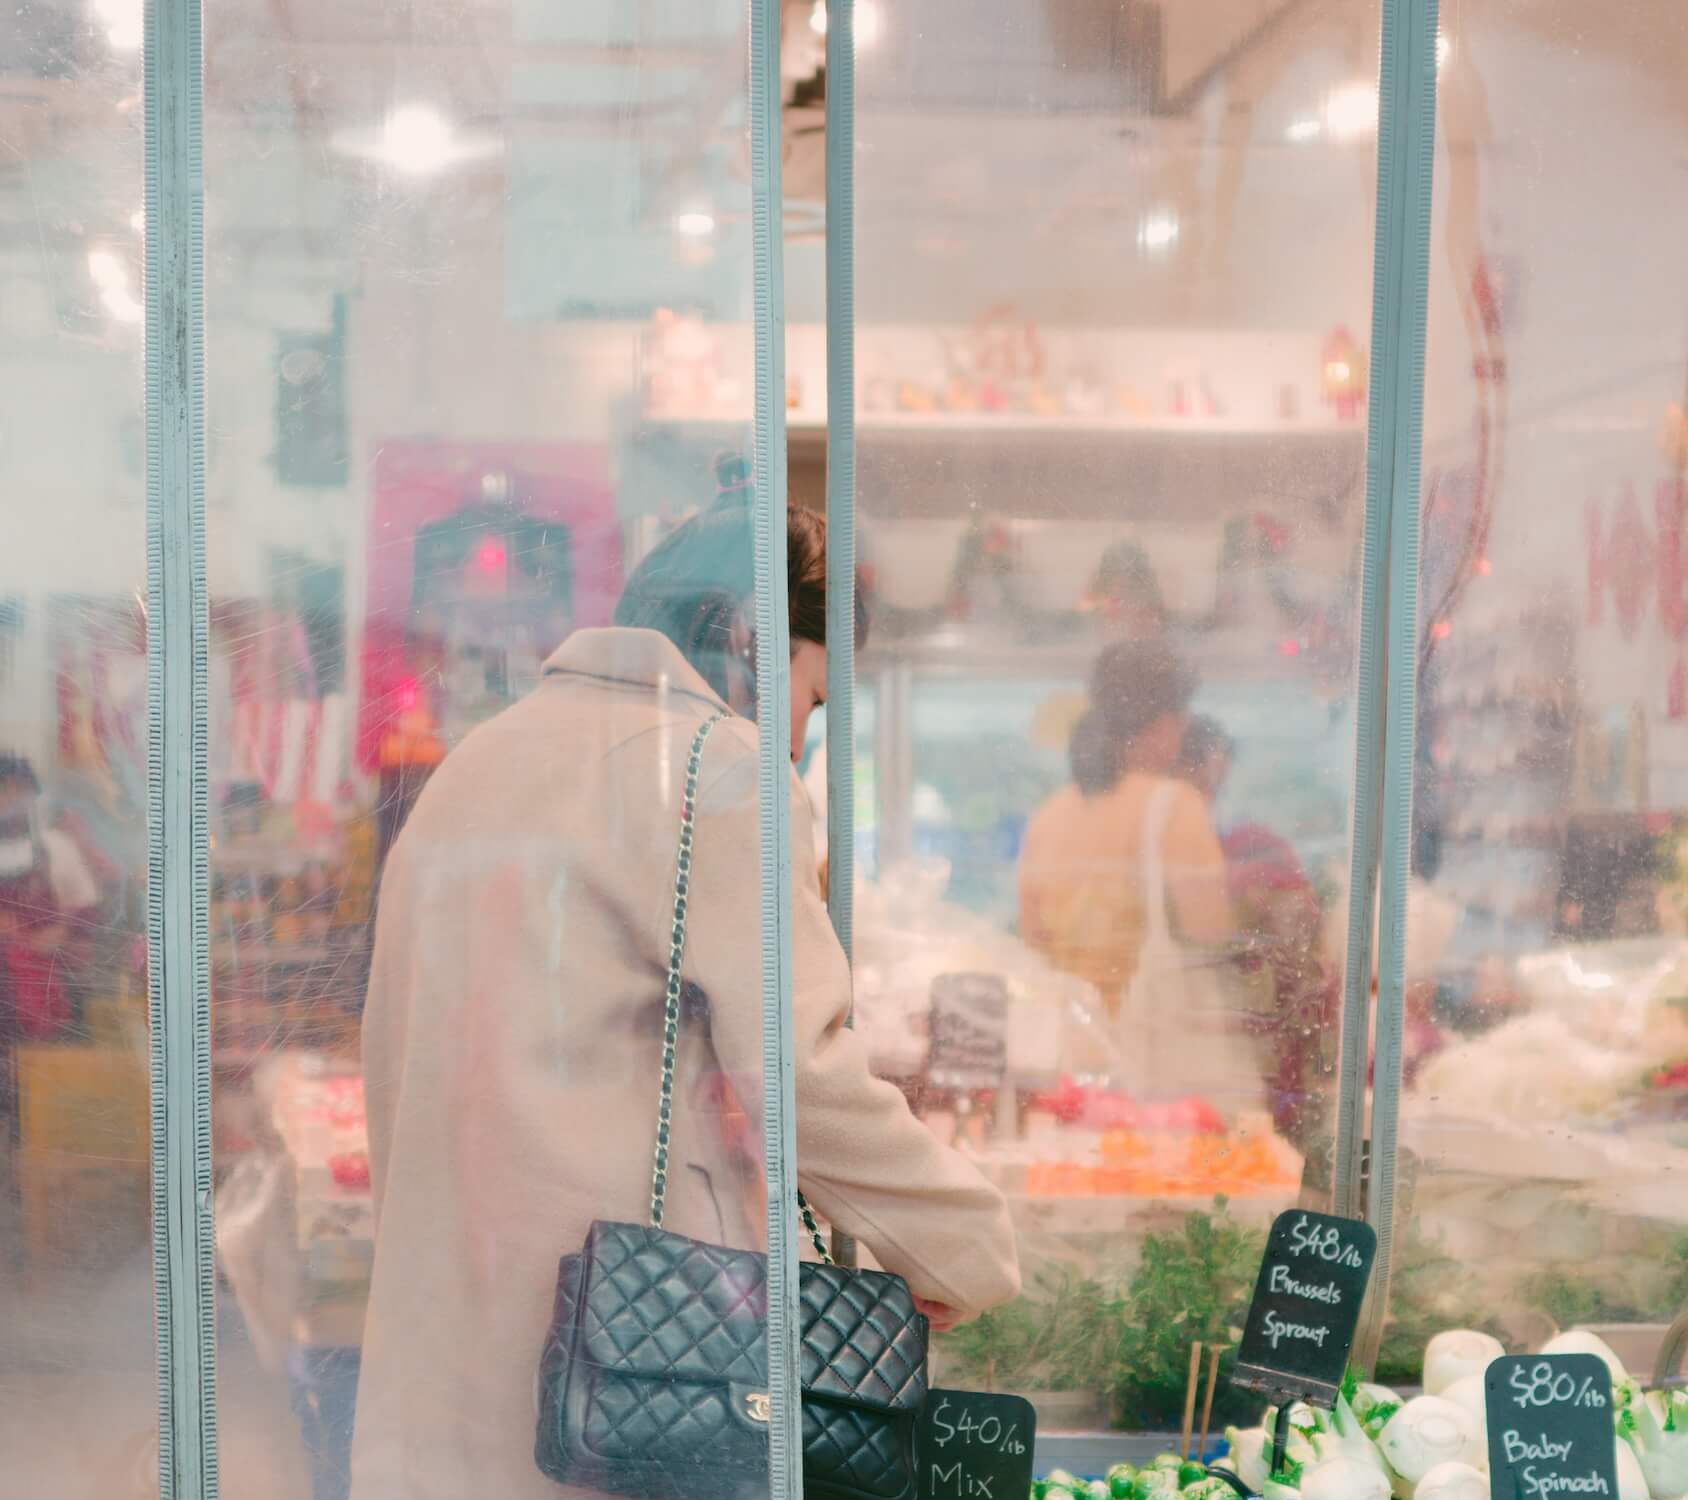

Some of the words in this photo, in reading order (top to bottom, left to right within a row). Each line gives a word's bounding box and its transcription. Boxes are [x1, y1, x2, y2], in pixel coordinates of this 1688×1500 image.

[1288, 1214, 1363, 1268] $48/lb
[1269, 1264, 1342, 1305] Brussels
[1261, 1310, 1330, 1350] Sprout
[1509, 1361, 1606, 1409] $80/lb
[932, 1397, 1026, 1455] $40/lb
[1503, 1429, 1573, 1464] Baby
[931, 1461, 995, 1500] Mix
